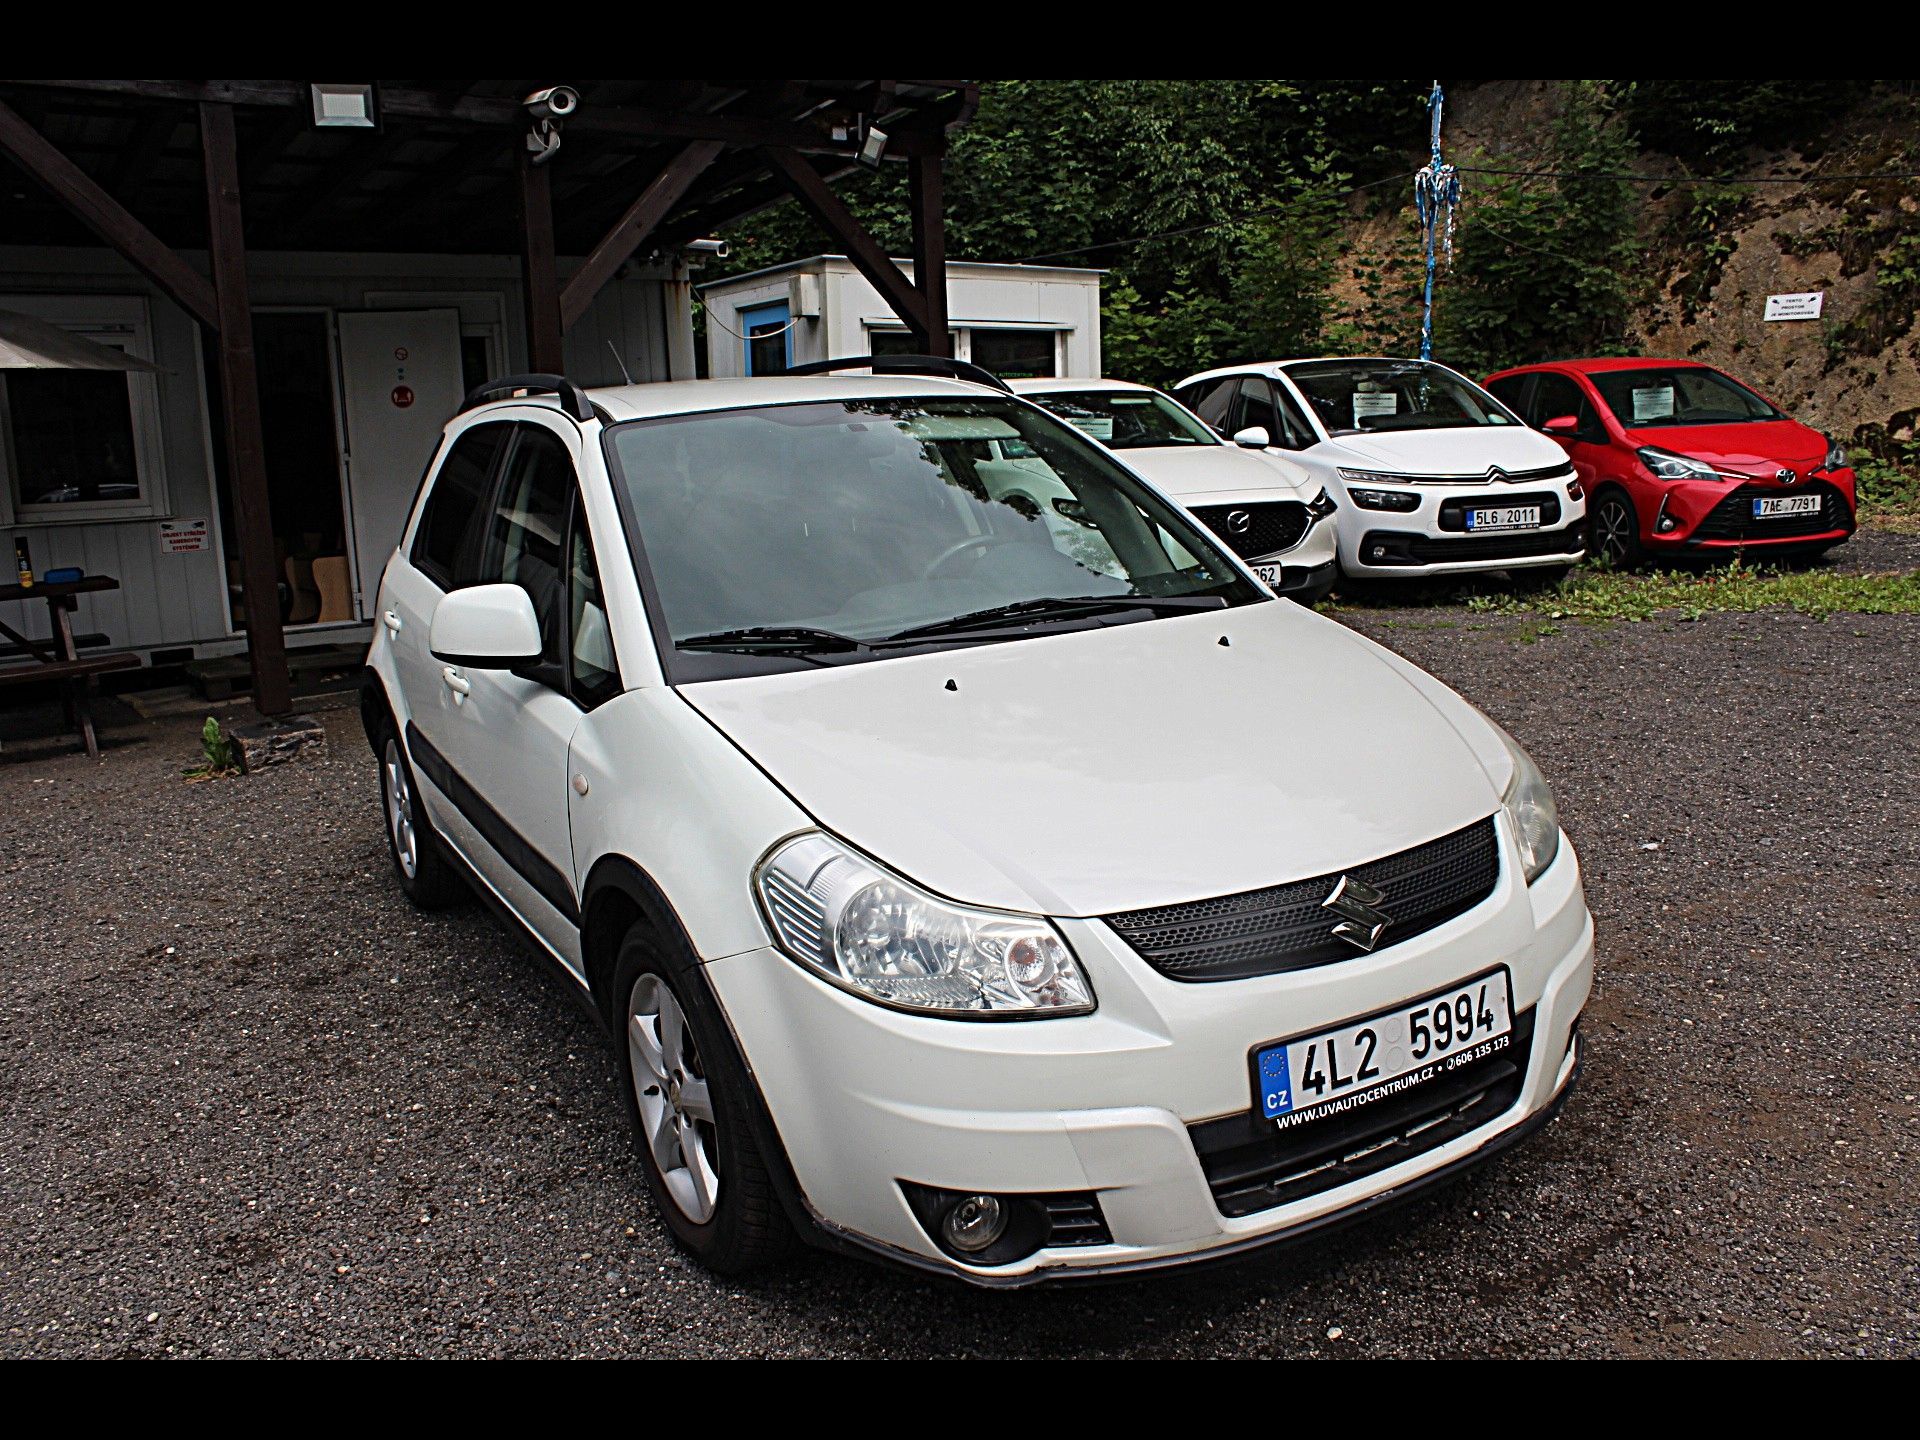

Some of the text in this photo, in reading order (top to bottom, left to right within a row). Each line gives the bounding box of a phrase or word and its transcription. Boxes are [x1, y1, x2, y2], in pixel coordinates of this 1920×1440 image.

[1763, 497, 1816, 513] 7AE 7791
[1476, 508, 1535, 525] 5L6 2011
[1302, 984, 1494, 1095] 4L2 5994
[1276, 1035, 1510, 1130] WWW.UVAUTOCENTRUM.CZ 606 135 173
[1266, 1089, 1289, 1109] CZ
